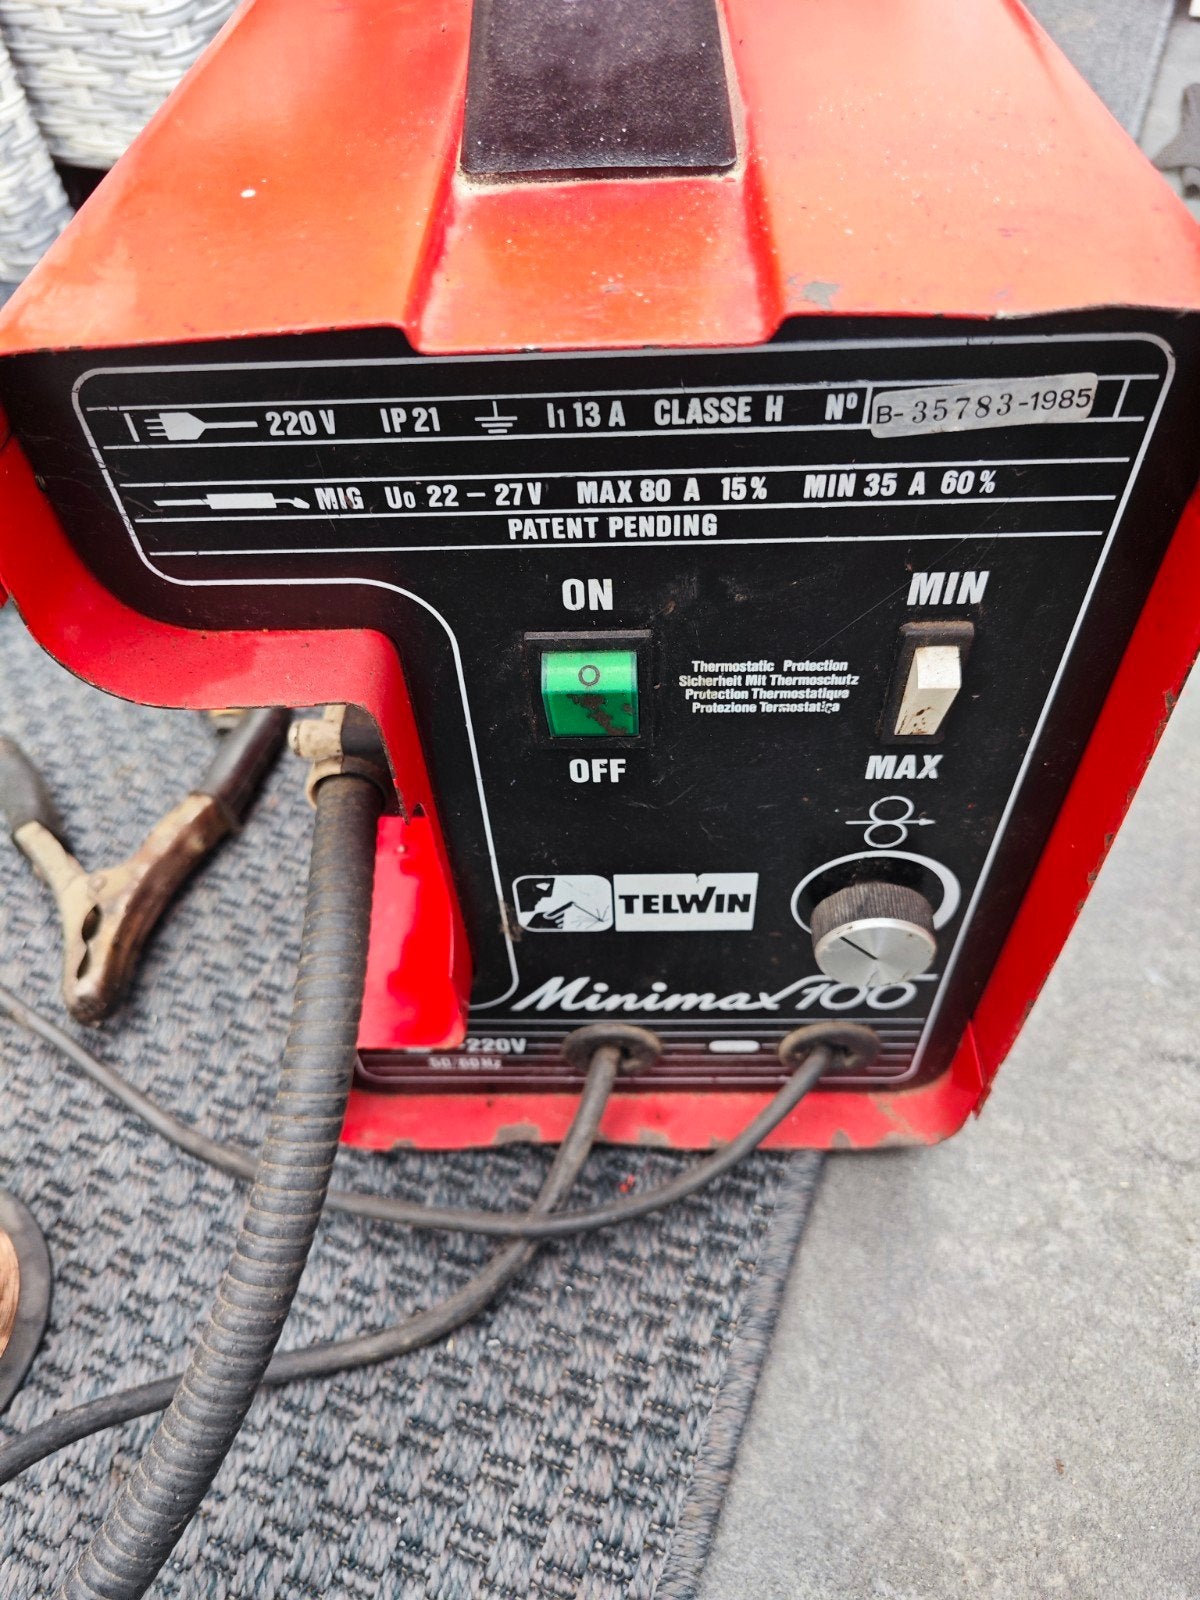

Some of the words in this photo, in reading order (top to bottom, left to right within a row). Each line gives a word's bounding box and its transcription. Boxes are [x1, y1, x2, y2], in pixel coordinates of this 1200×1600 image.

[572, 402, 601, 427] 13
[608, 401, 626, 427] A
[654, 396, 752, 425] CLASSE
[765, 395, 784, 421] H
[577, 480, 633, 504] MAX
[639, 479, 671, 502] 80
[683, 478, 700, 501] A
[803, 473, 857, 498] MIN
[863, 473, 898, 497] 35
[908, 471, 926, 495] A
[314, 487, 363, 511] MIG
[427, 485, 460, 508] 22
[508, 516, 599, 539] PATENT
[608, 513, 718, 538] PENDING
[562, 578, 613, 611] ON
[907, 571, 990, 605] MIN
[692, 660, 775, 673] Thermostatic
[783, 659, 848, 672] Protection
[679, 675, 742, 687] Sicherheit
[745, 674, 767, 686] Mit
[770, 673, 860, 686] Thermoschutz
[751, 687, 850, 700] Thermostatique
[692, 702, 757, 713] Protezione
[569, 758, 626, 783] OFF
[865, 754, 944, 780] MAX
[619, 886, 752, 914] TELWIN
